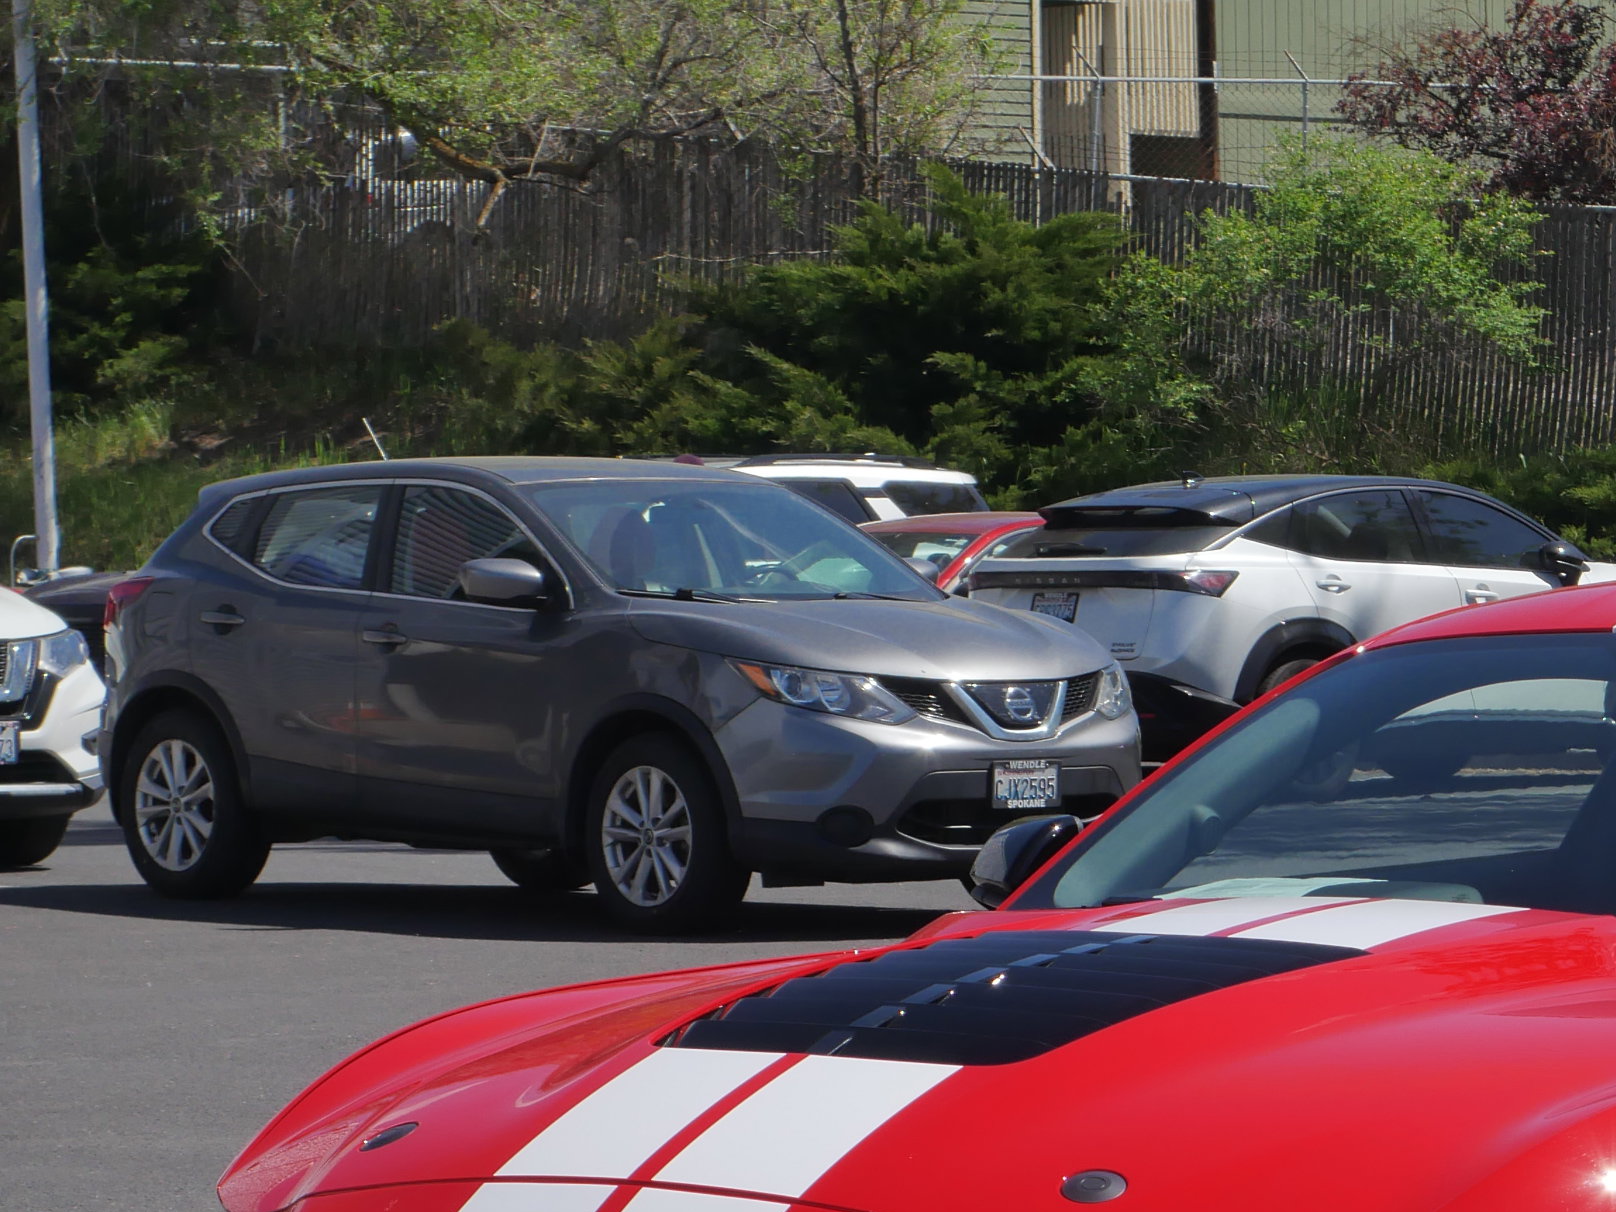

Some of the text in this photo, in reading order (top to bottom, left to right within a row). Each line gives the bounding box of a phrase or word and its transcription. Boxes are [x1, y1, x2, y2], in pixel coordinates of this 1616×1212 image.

[1009, 759, 1046, 769] WENDLE
[995, 776, 1055, 800] CJX2595
[1007, 799, 1046, 809] SPOKANE
